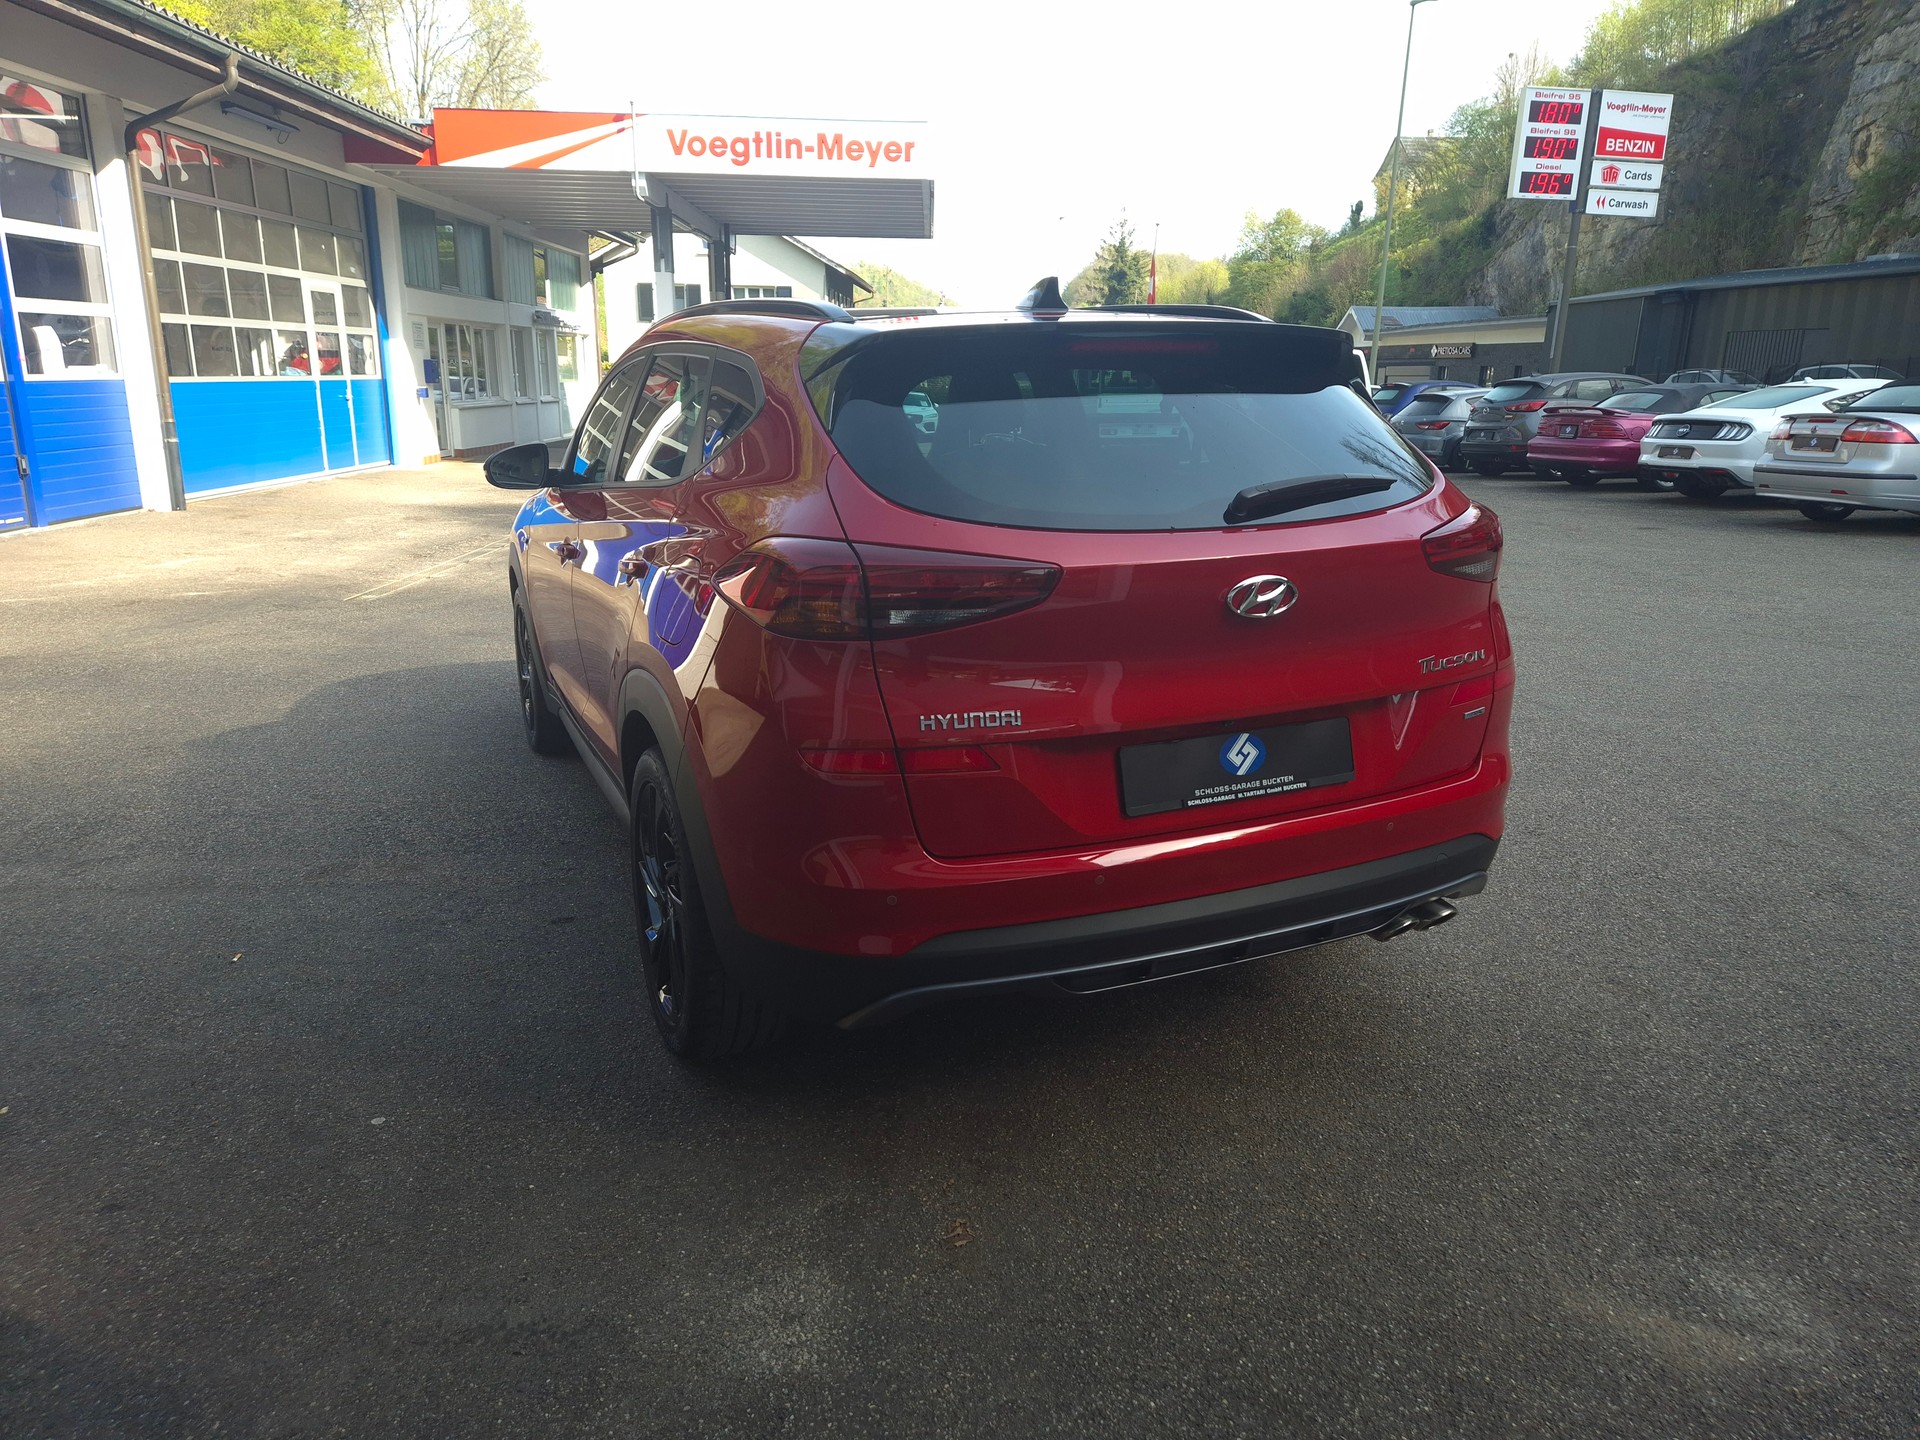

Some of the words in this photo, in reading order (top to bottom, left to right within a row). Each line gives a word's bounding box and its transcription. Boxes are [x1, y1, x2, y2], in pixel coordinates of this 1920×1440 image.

[1535, 91, 1565, 99] Bleifrei
[1606, 101, 1667, 115] Voegtlin-Meyer
[1530, 127, 1561, 135] Bleifrei
[1563, 128, 1577, 136] 98
[666, 128, 915, 167] Voegtlin-Meyer
[1605, 138, 1655, 153] BENZIN
[1535, 163, 1562, 171] Diesel
[1624, 170, 1653, 181] Cards
[1608, 198, 1648, 209] Carwash
[920, 710, 1021, 731] HYUNDAI
[1194, 780, 1261, 796] SCHLOSS-GARAGE
[1262, 775, 1294, 786] BUCKTEN
[1187, 794, 1236, 806] SCHLOSS-GARAGE
[1266, 785, 1282, 794] GmbH
[1282, 782, 1307, 791] BUCKTEN
